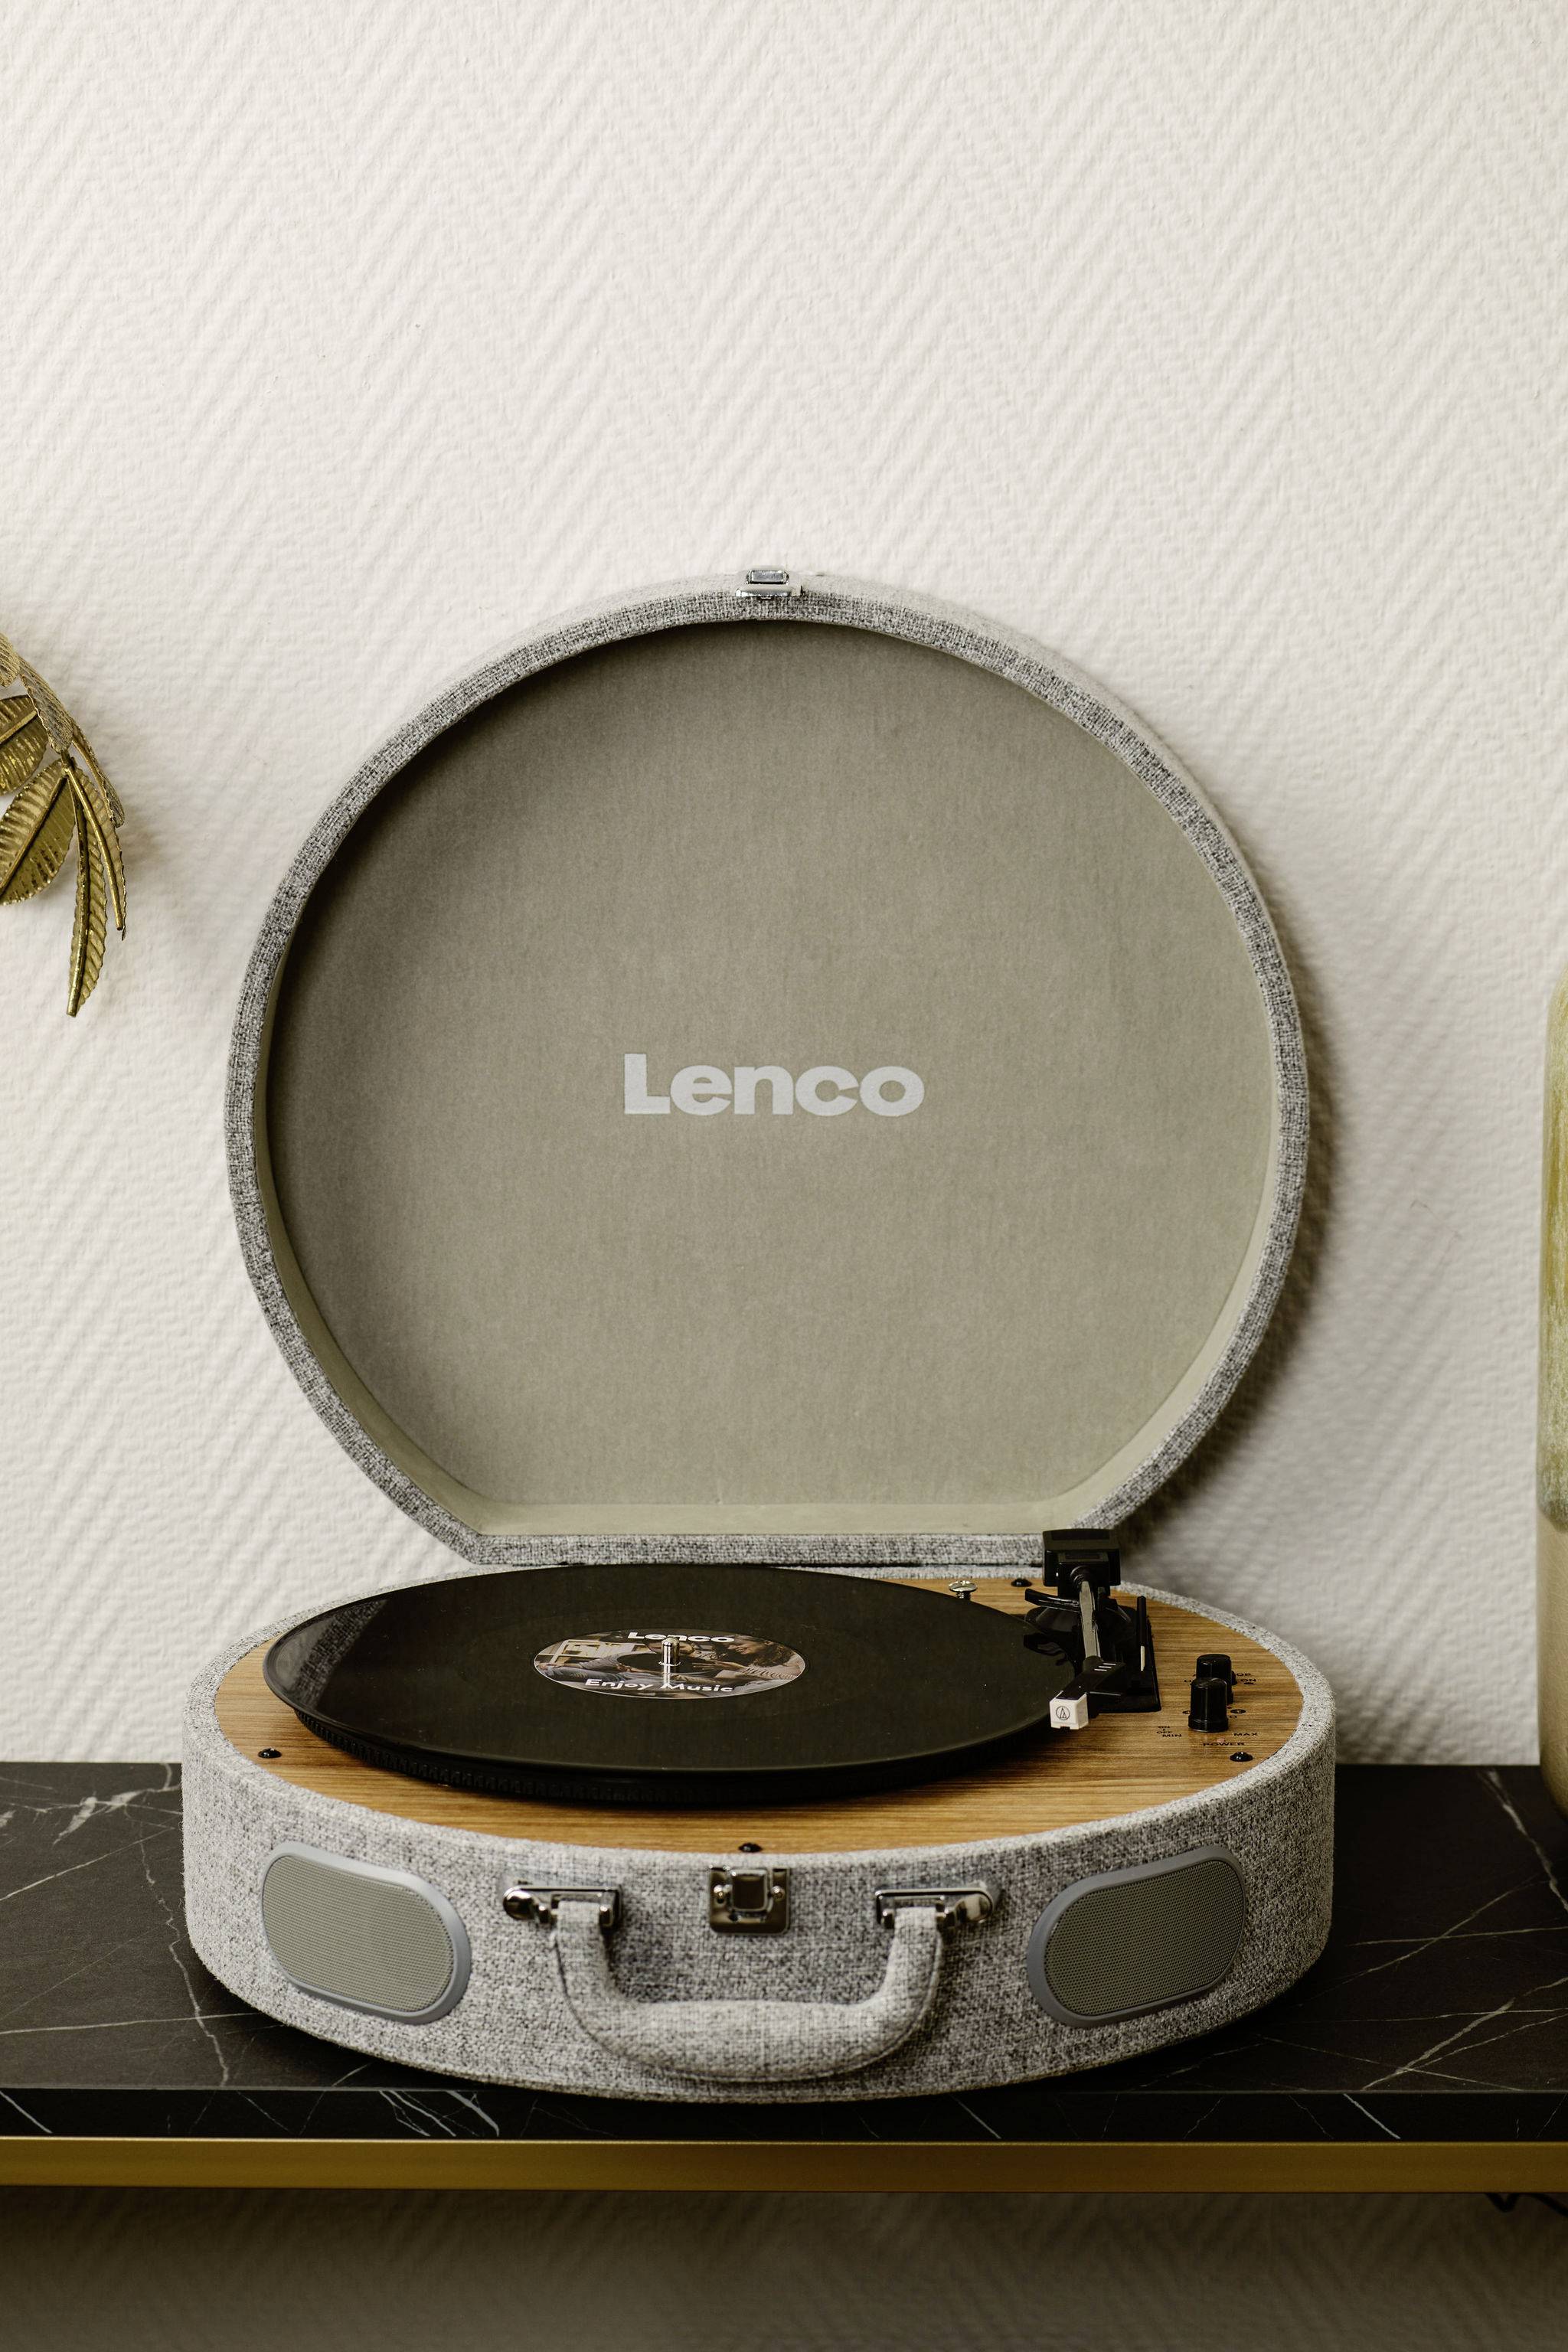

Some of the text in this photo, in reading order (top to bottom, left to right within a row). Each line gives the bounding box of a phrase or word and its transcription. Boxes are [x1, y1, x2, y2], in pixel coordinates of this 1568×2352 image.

[624, 1053, 925, 1117] Lenco
[628, 1632, 735, 1643] Lenco
[585, 1678, 732, 1692] Enjoy Music
